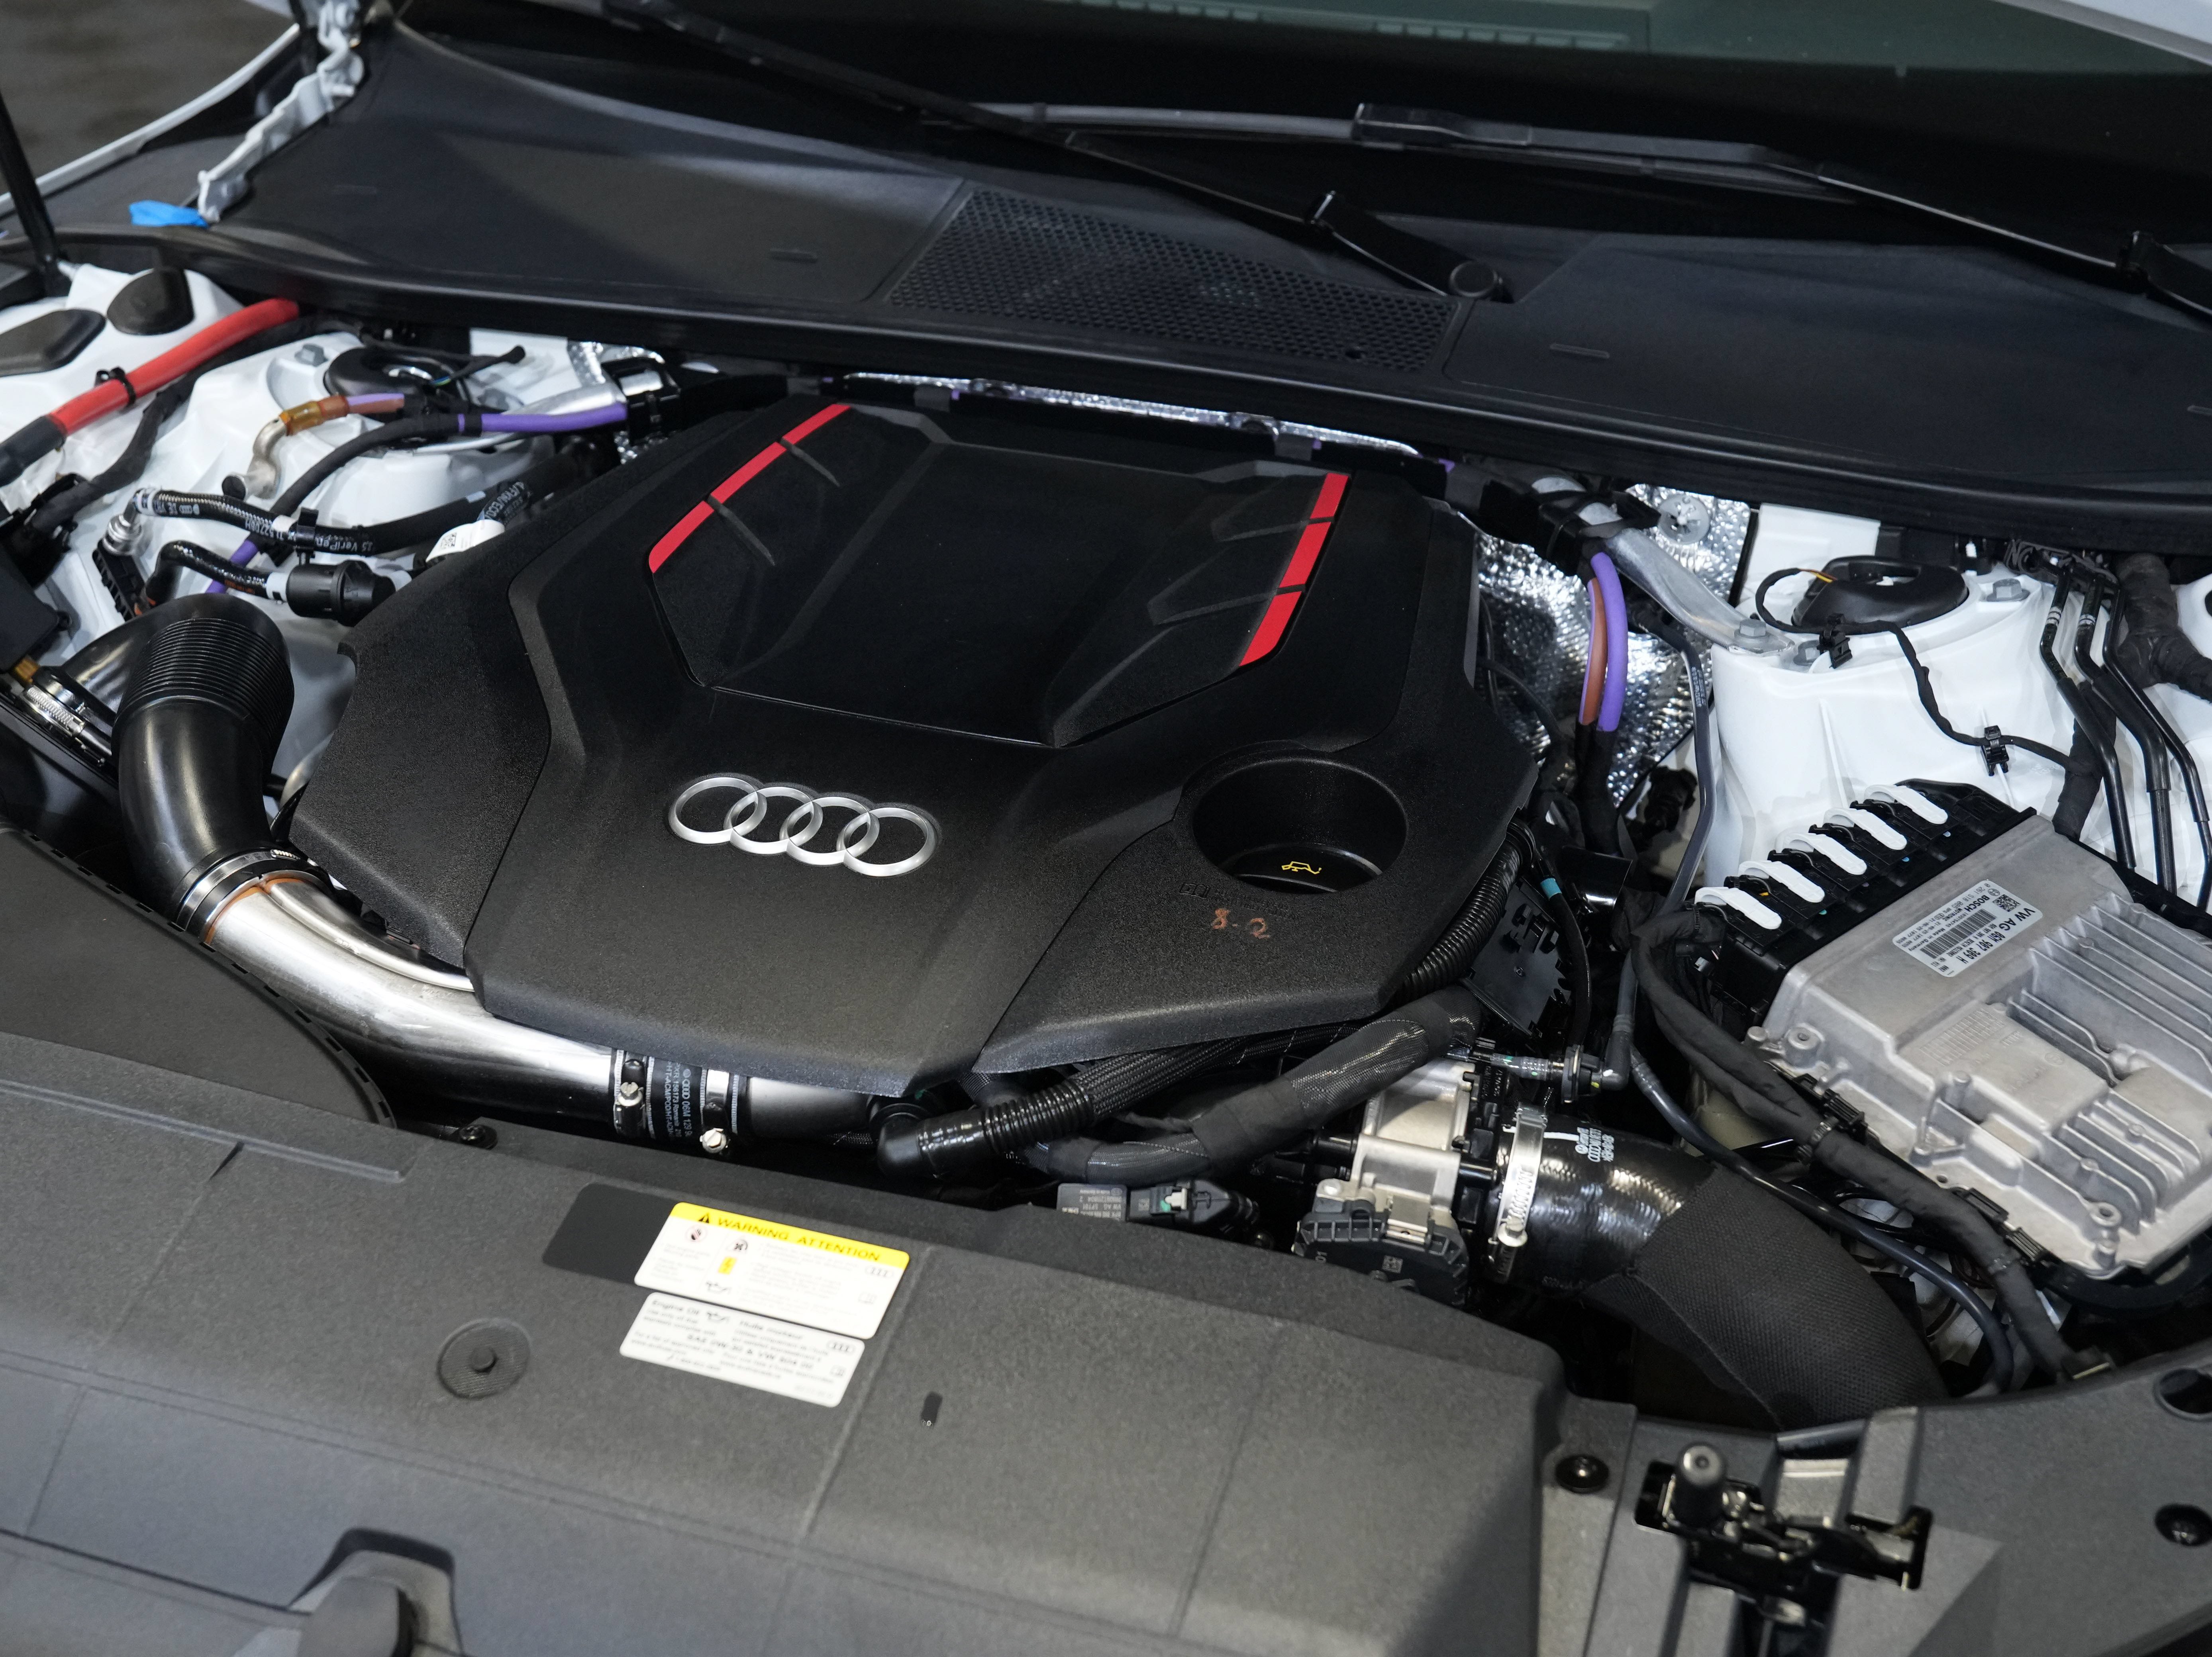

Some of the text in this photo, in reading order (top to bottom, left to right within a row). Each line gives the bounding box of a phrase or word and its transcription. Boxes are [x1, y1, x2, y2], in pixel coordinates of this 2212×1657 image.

[1963, 895, 1990, 912] BOSCH
[1941, 908, 1963, 921] MOTRONIC
[2012, 907, 2036, 921] VW
[1932, 927, 1945, 936] Made
[1996, 918, 2018, 932] AG
[1986, 930, 2006, 943] 06M
[1907, 938, 1929, 952] Germany
[1974, 938, 1993, 951] 907
[718, 1218, 789, 1240] WARNING
[797, 1234, 880, 1261] ATTENTION
